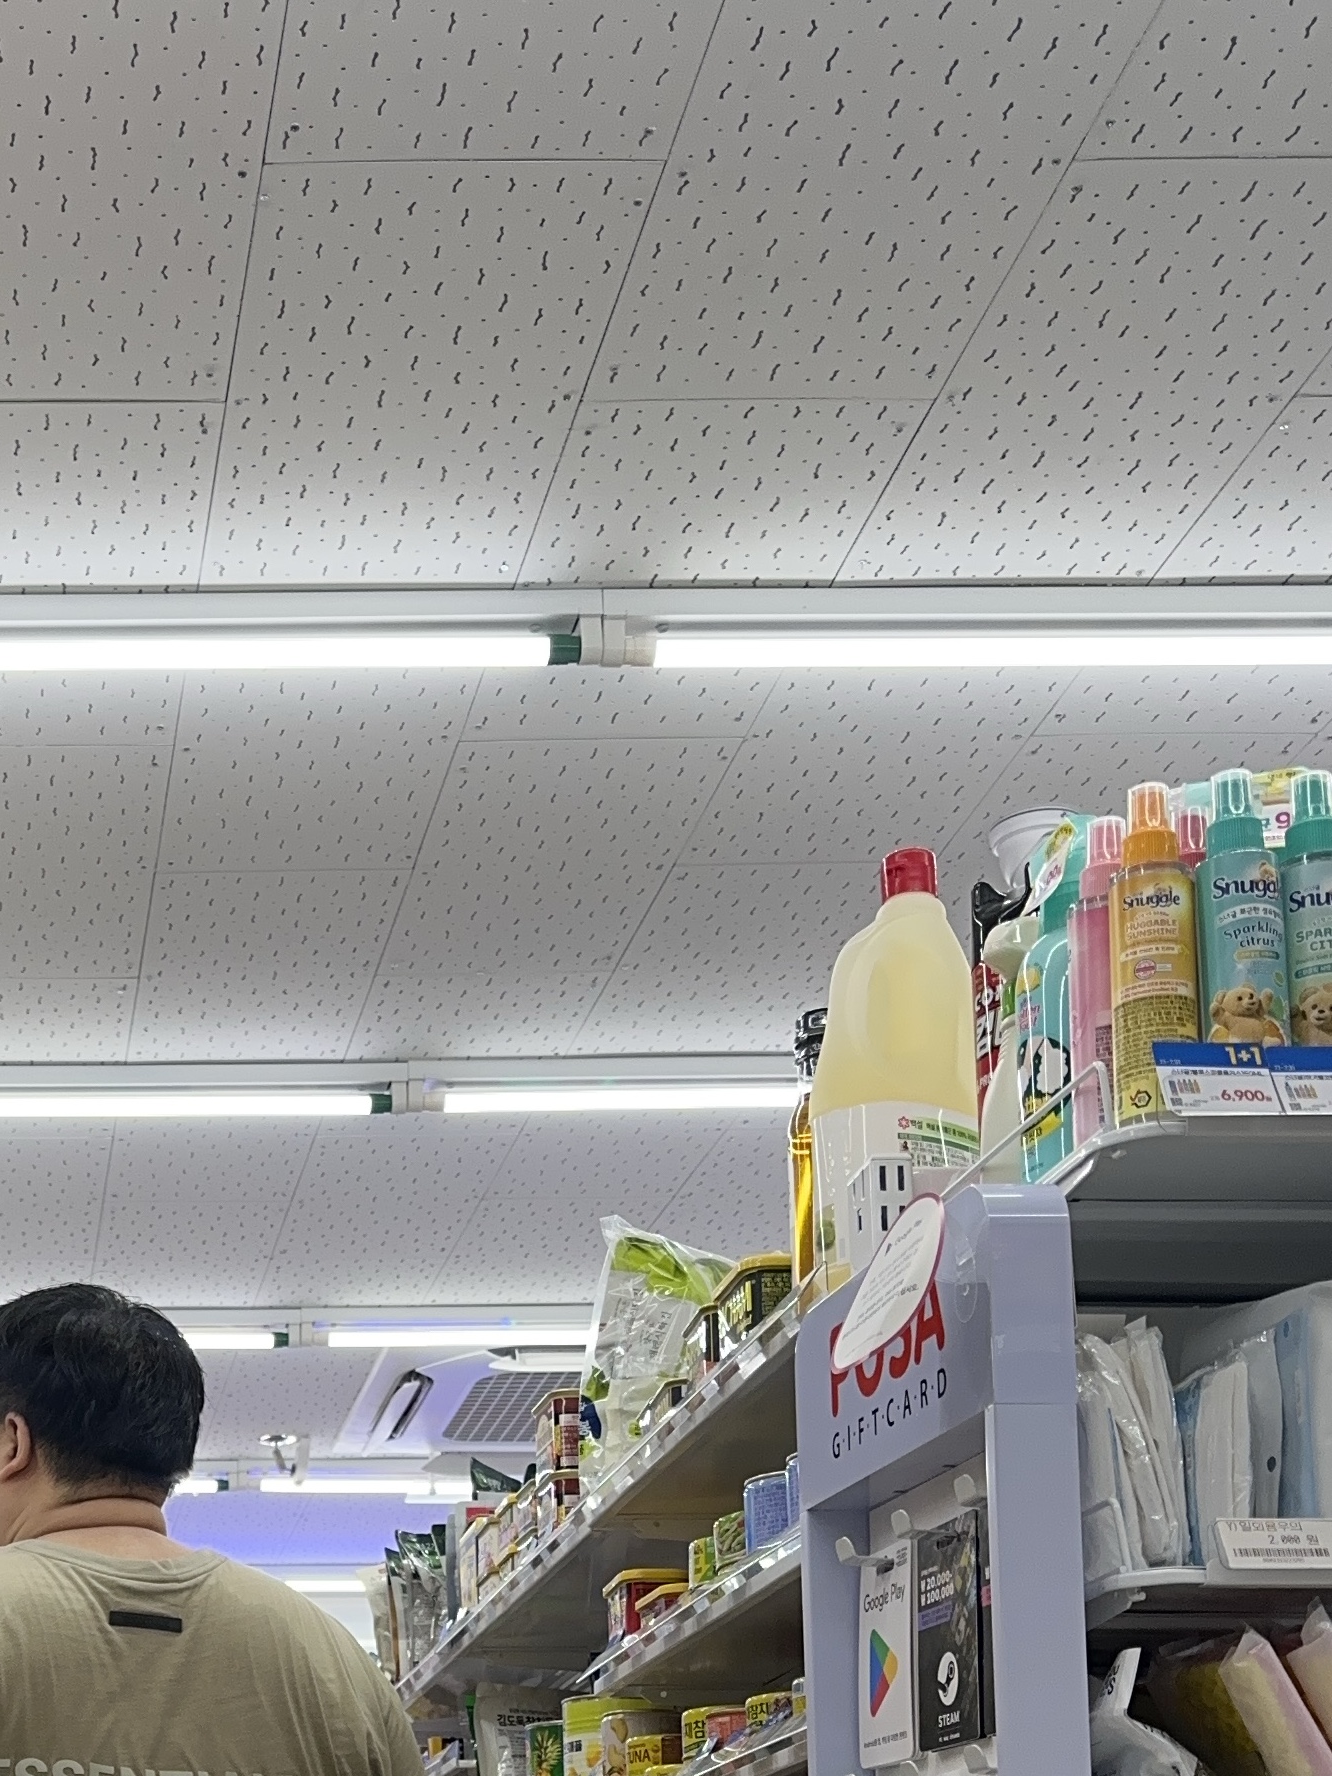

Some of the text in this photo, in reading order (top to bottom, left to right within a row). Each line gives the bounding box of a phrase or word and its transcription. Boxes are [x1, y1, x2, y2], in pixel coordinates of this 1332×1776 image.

[1123, 889, 1181, 912] Snuggle
[1125, 918, 1178, 931] HUGGABLE
[1126, 927, 1178, 940] SUNSHINE
[1222, 921, 1284, 944] Sparkling
[1239, 935, 1276, 948] citrus
[1224, 1045, 1263, 1066] 1+1
[863, 1582, 906, 1613] Google Play
[937, 1710, 960, 1728] STEAM
